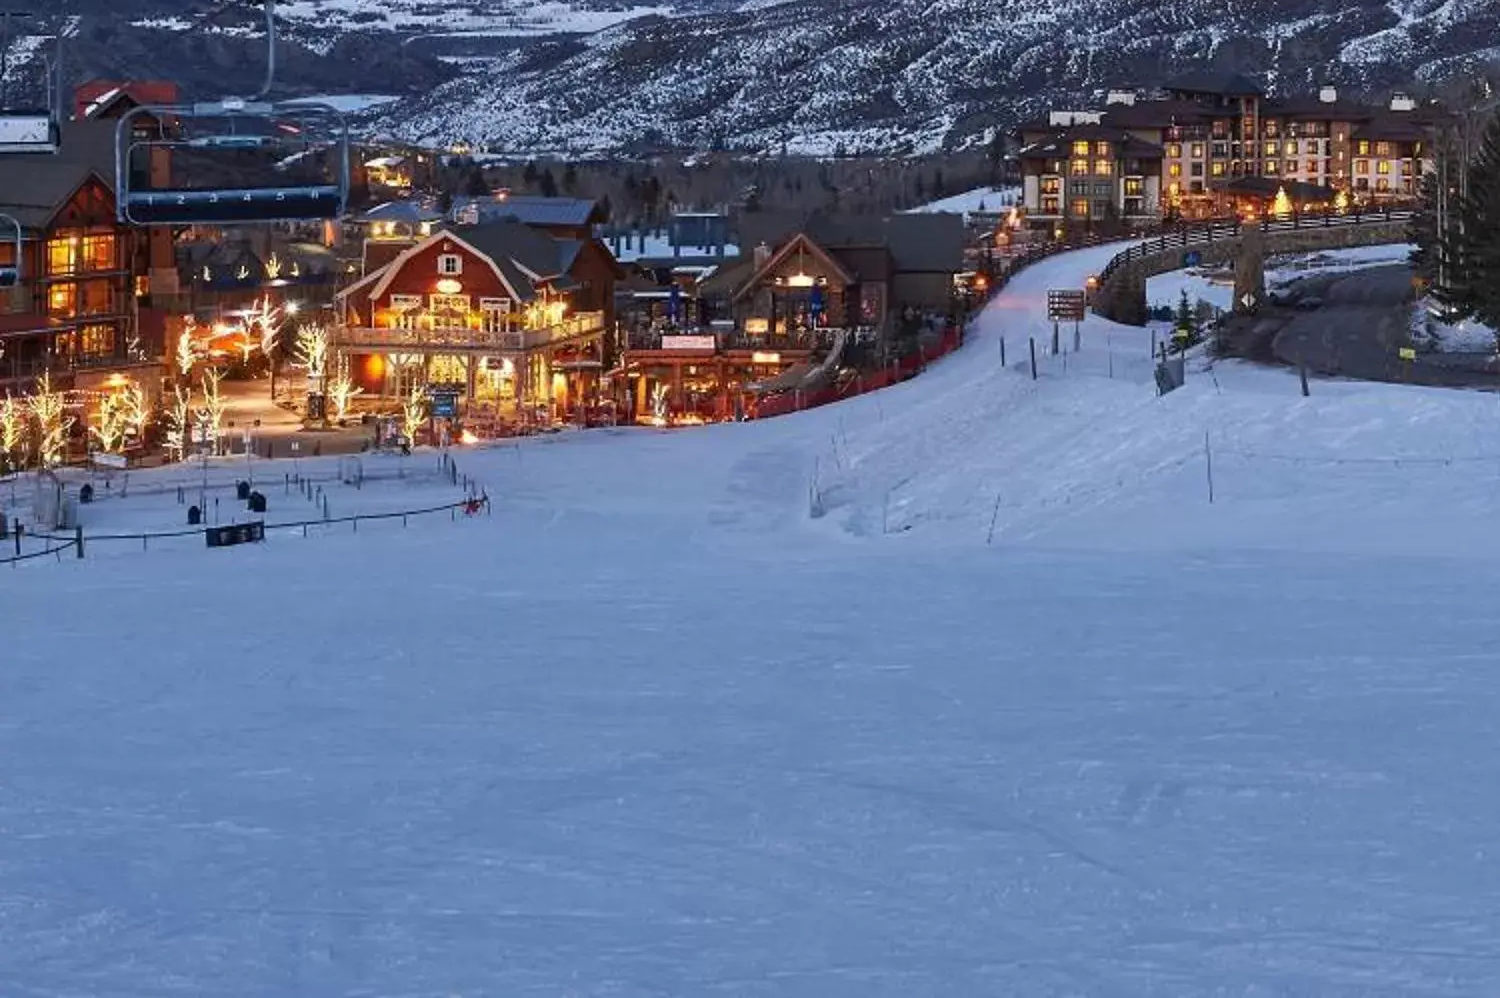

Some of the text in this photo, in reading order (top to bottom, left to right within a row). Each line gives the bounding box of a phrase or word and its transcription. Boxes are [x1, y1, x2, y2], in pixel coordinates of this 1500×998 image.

[176, 194, 186, 205] 2
[209, 192, 218, 203] 3
[242, 191, 251, 202] 4
[275, 191, 285, 201] 5
